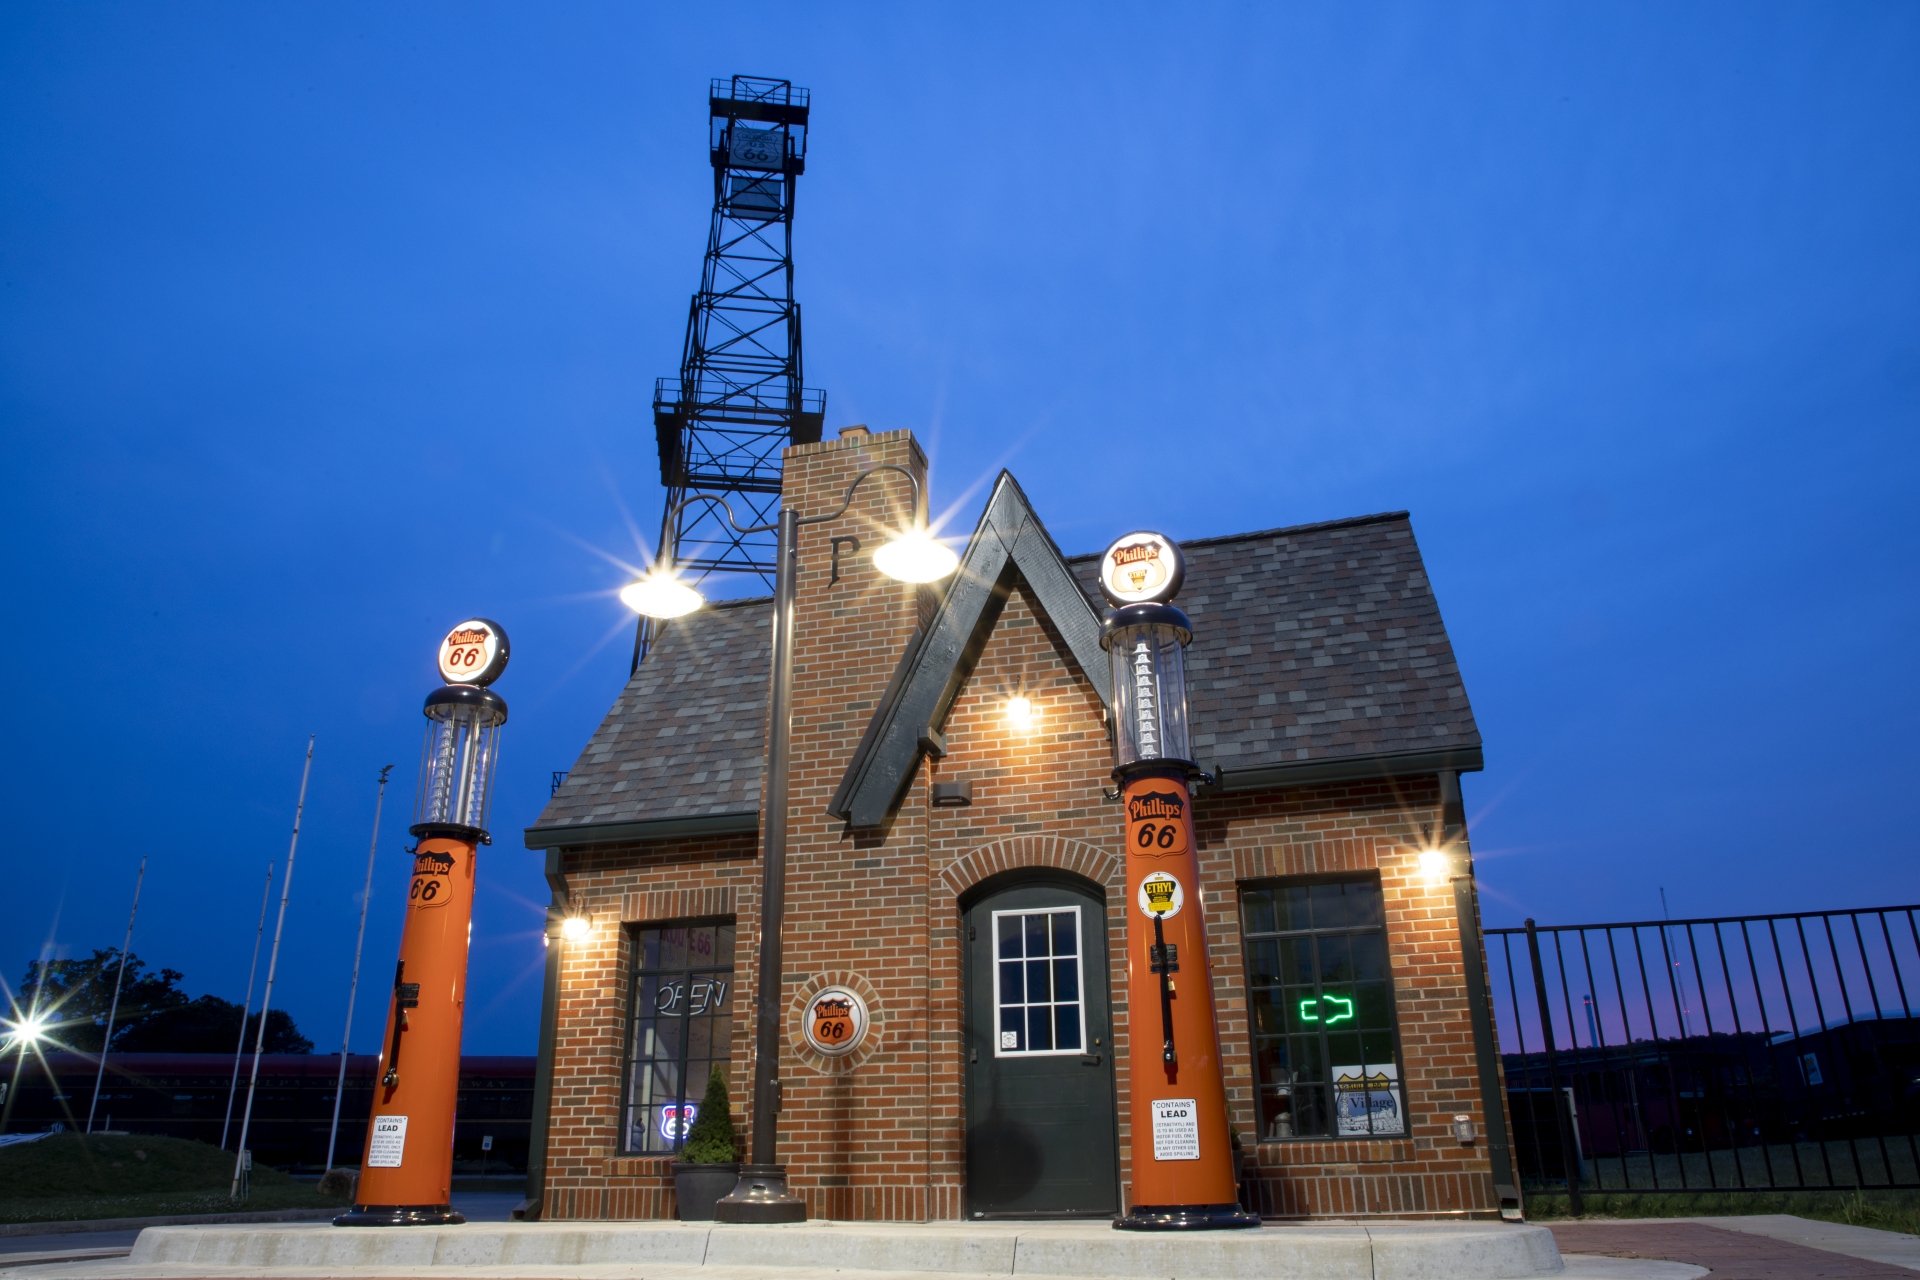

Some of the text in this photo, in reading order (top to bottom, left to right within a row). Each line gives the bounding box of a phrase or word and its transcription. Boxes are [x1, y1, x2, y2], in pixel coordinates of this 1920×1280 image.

[744, 148, 769, 161] 66
[829, 535, 861, 588] P
[1114, 546, 1159, 565] Phillips
[450, 631, 485, 646] Phillips
[450, 647, 480, 667] 66
[1131, 797, 1181, 820] Phillips
[1138, 823, 1177, 849] 66
[410, 878, 441, 901] 66
[1146, 881, 1174, 895] ETHYL
[664, 928, 696, 951] ROUE
[697, 931, 711, 956] 66
[816, 1002, 849, 1019] Phillips
[820, 1021, 845, 1039] 66
[1350, 1096, 1394, 1110] Vilage
[1160, 1110, 1187, 1118] LEAD
